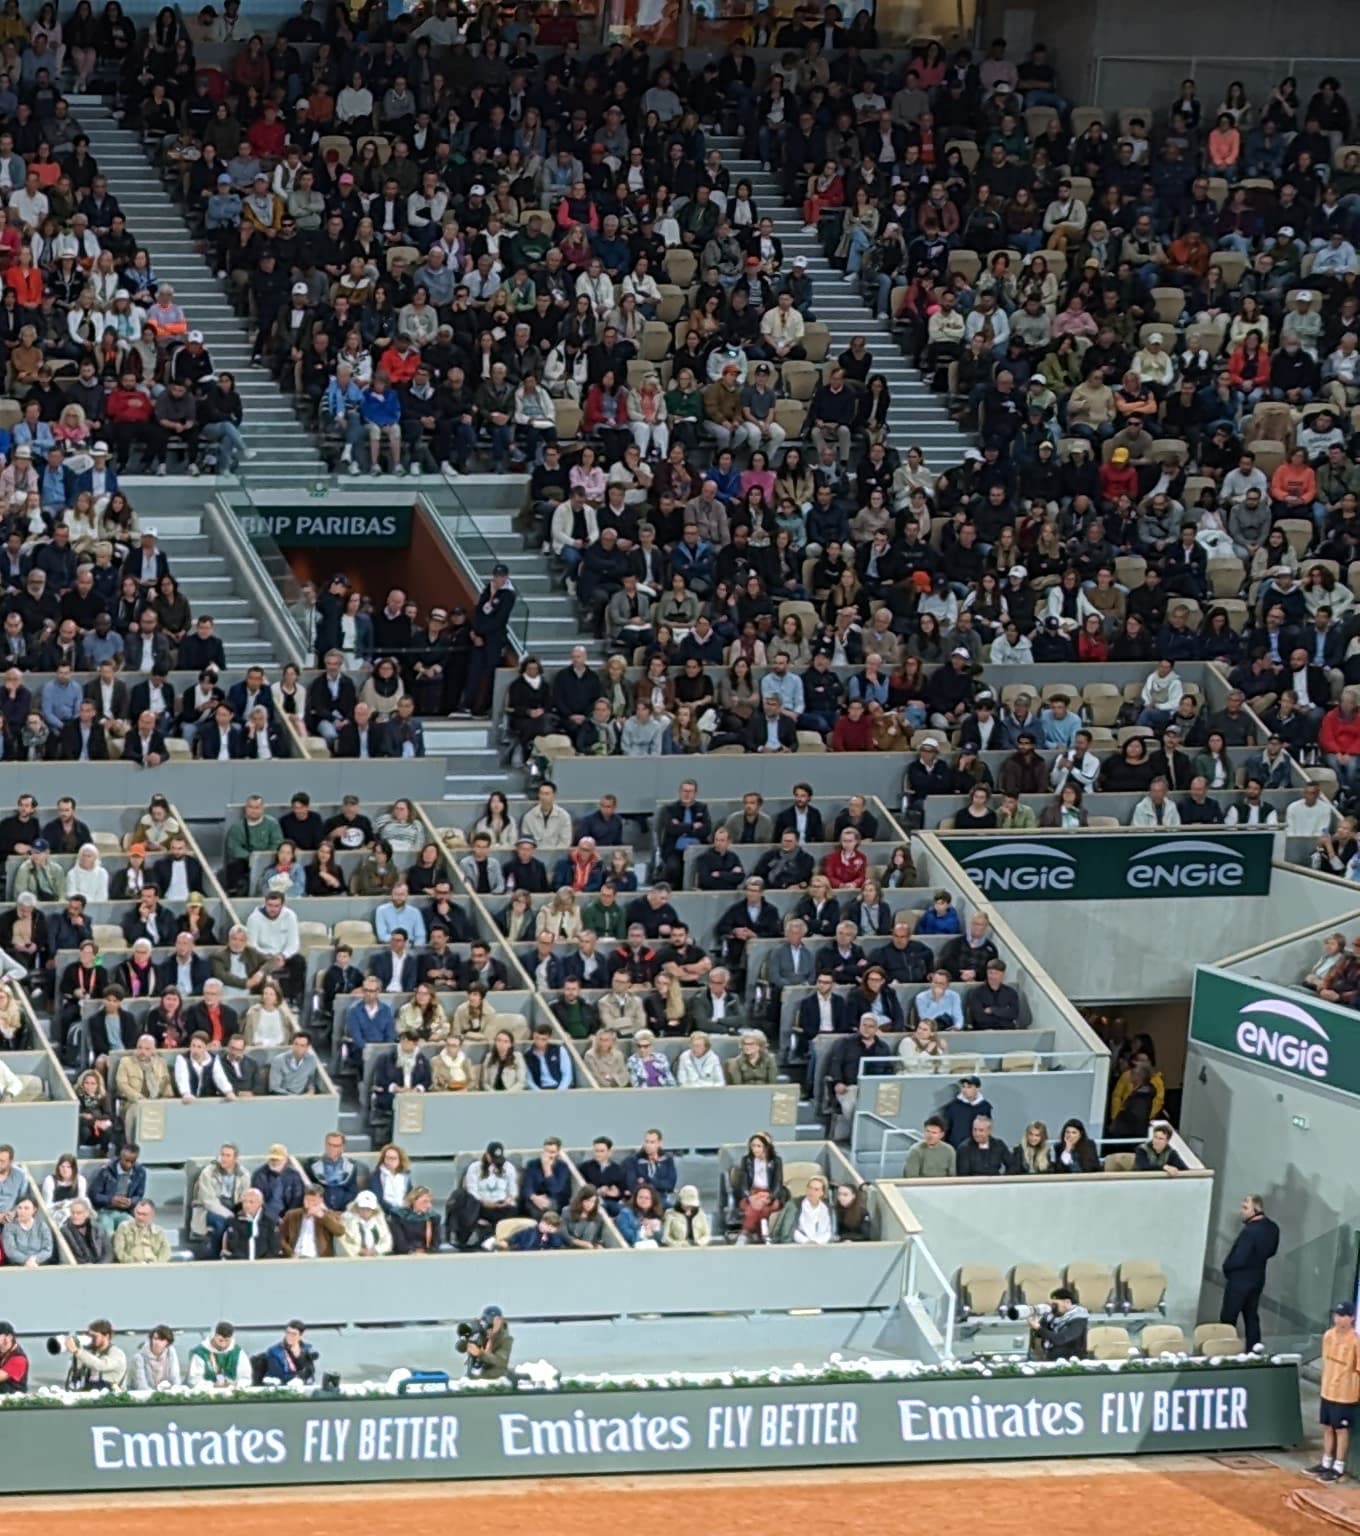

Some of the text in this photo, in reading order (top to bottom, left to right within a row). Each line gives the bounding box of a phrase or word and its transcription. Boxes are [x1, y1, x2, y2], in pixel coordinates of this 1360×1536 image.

[296, 516, 397, 535] PARIBAS
[90, 1414, 459, 1471] Emirates FLY BETTER
[498, 1401, 859, 1457] Emirates FLY BETTER
[896, 1386, 1249, 1443] Emirates FLY BETTER
